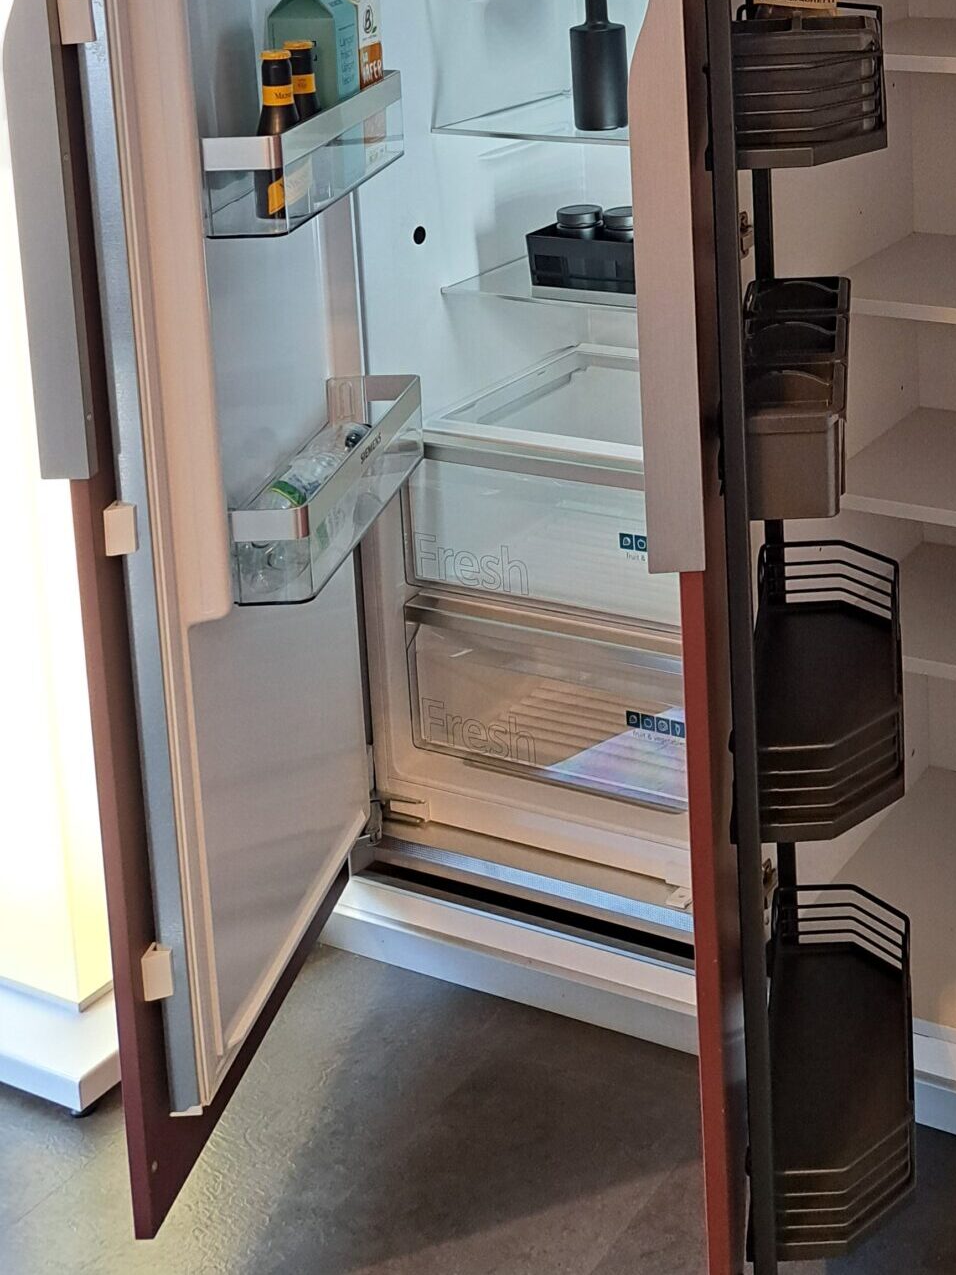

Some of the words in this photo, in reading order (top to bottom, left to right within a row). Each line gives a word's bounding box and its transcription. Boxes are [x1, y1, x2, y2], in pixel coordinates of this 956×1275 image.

[360, 432, 382, 464] SIEMENS
[413, 531, 529, 596] Fresh
[421, 697, 536, 764] Fresh
